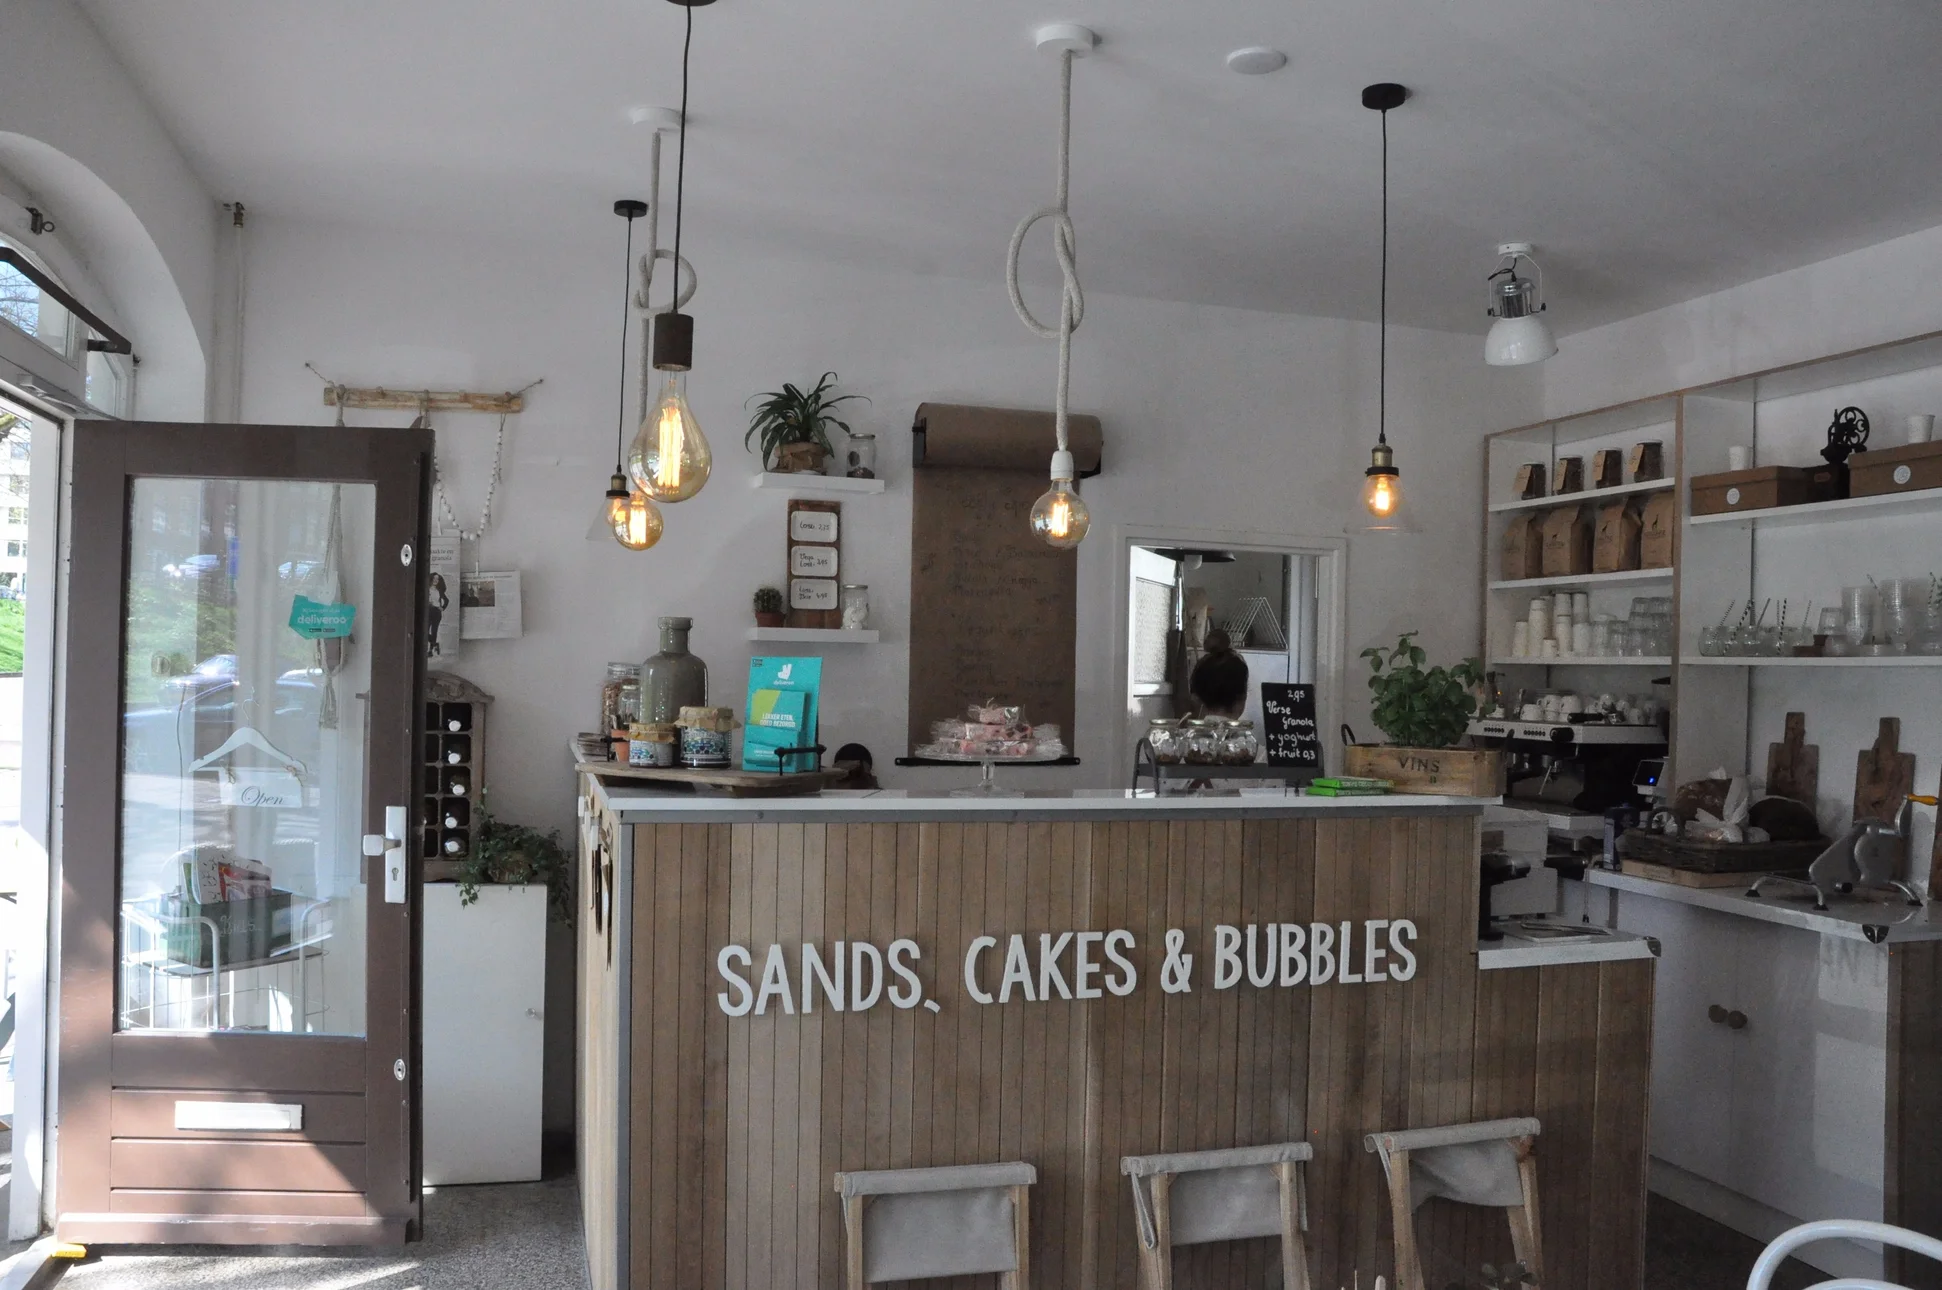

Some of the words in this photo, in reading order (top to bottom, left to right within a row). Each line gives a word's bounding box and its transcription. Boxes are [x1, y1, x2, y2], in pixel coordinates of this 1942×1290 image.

[297, 614, 347, 625] deliveroo
[1266, 700, 1291, 715] Verse
[1278, 731, 1316, 747] yoghurt
[1278, 747, 1300, 758] fruit
[1398, 757, 1440, 773] VINS
[241, 786, 284, 807] Open
[964, 928, 1138, 1004] CAKES
[1160, 927, 1193, 994] &
[1214, 918, 1418, 991] BUBBLES
